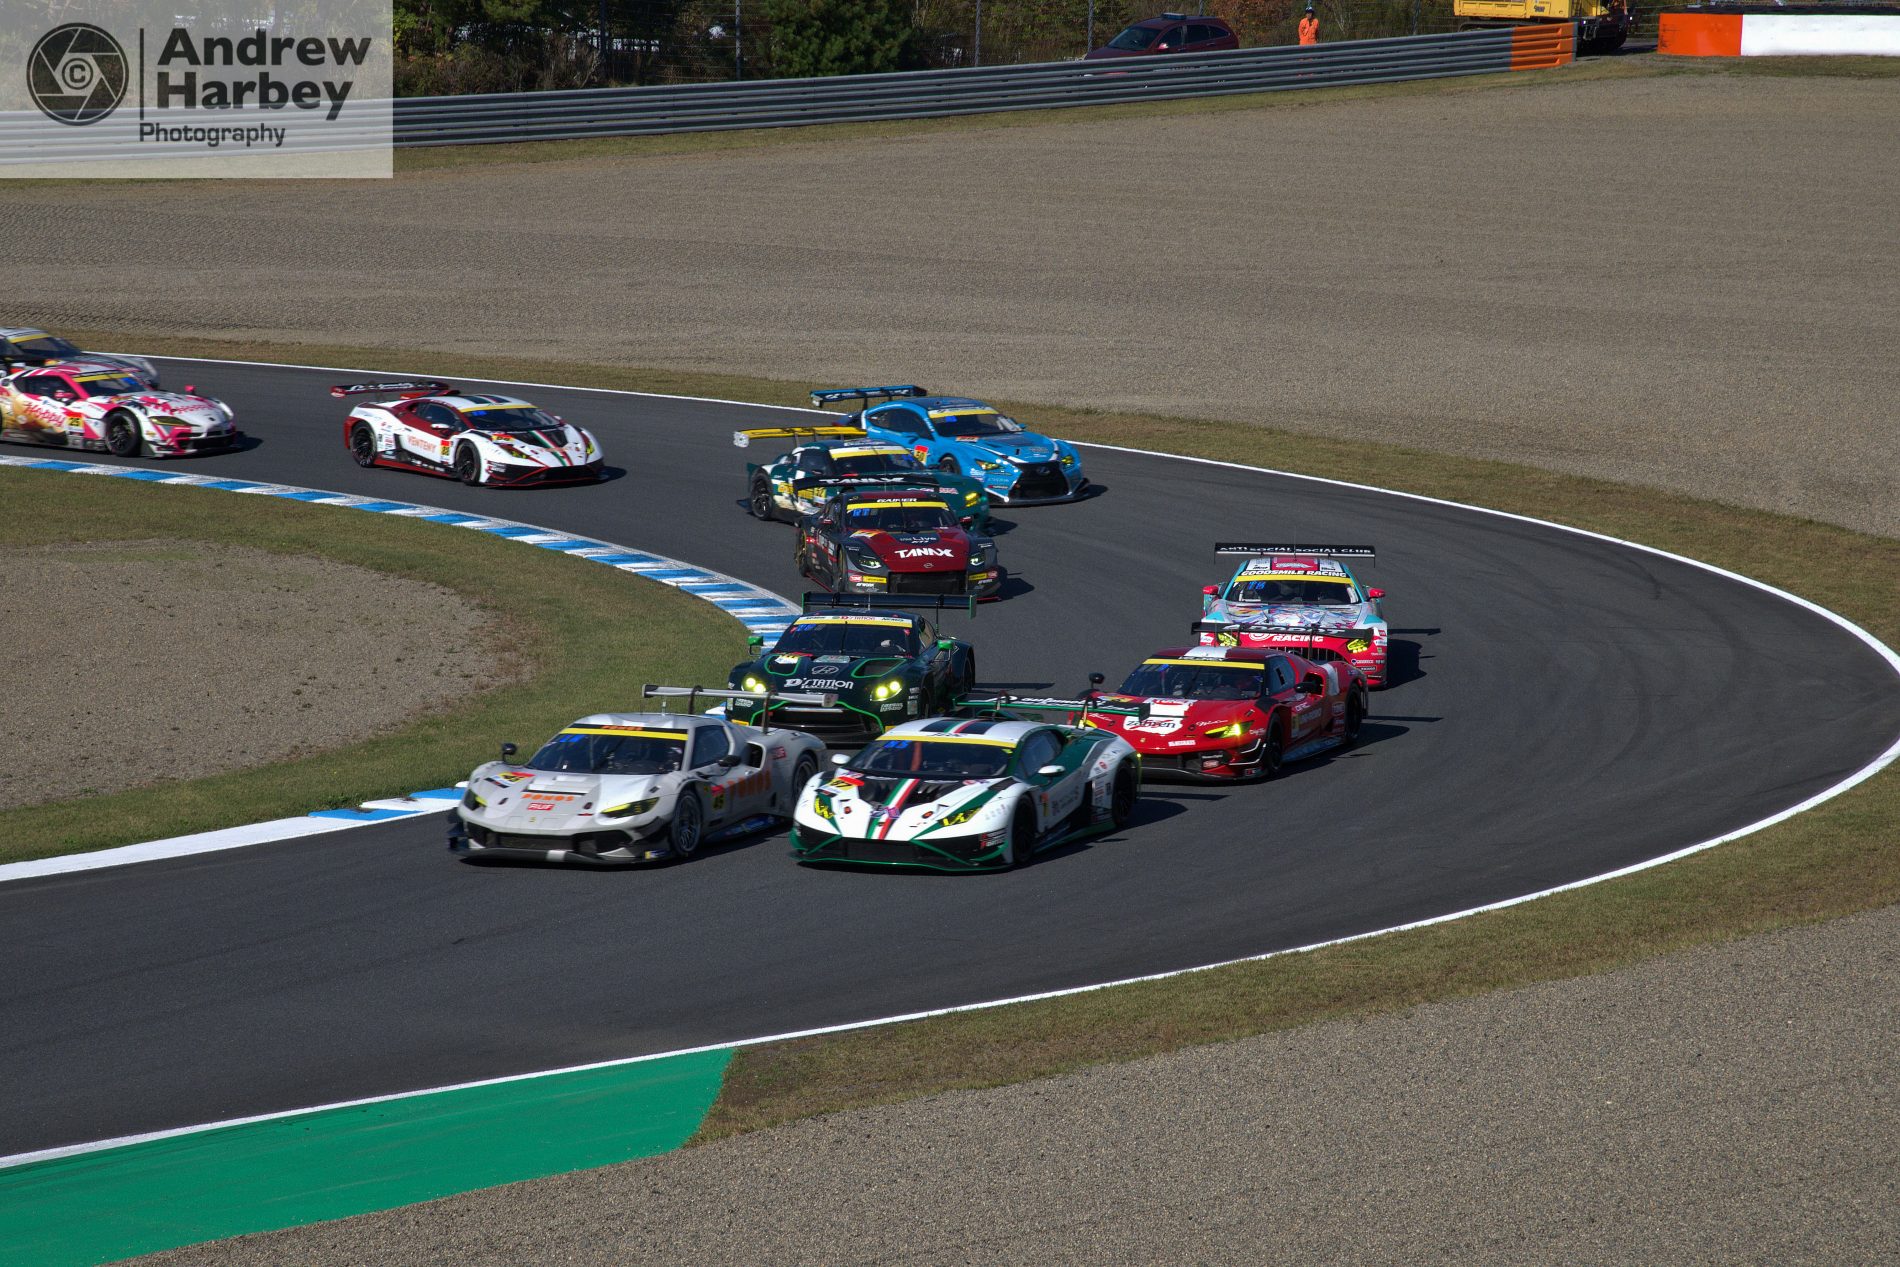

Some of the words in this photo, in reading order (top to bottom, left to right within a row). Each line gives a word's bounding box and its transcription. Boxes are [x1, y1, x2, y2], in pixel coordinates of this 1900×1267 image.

[894, 548, 954, 559] TANAX
[1306, 570, 1348, 578] RACING
[1272, 635, 1324, 643] RACING
[521, 793, 575, 802] PONOS
